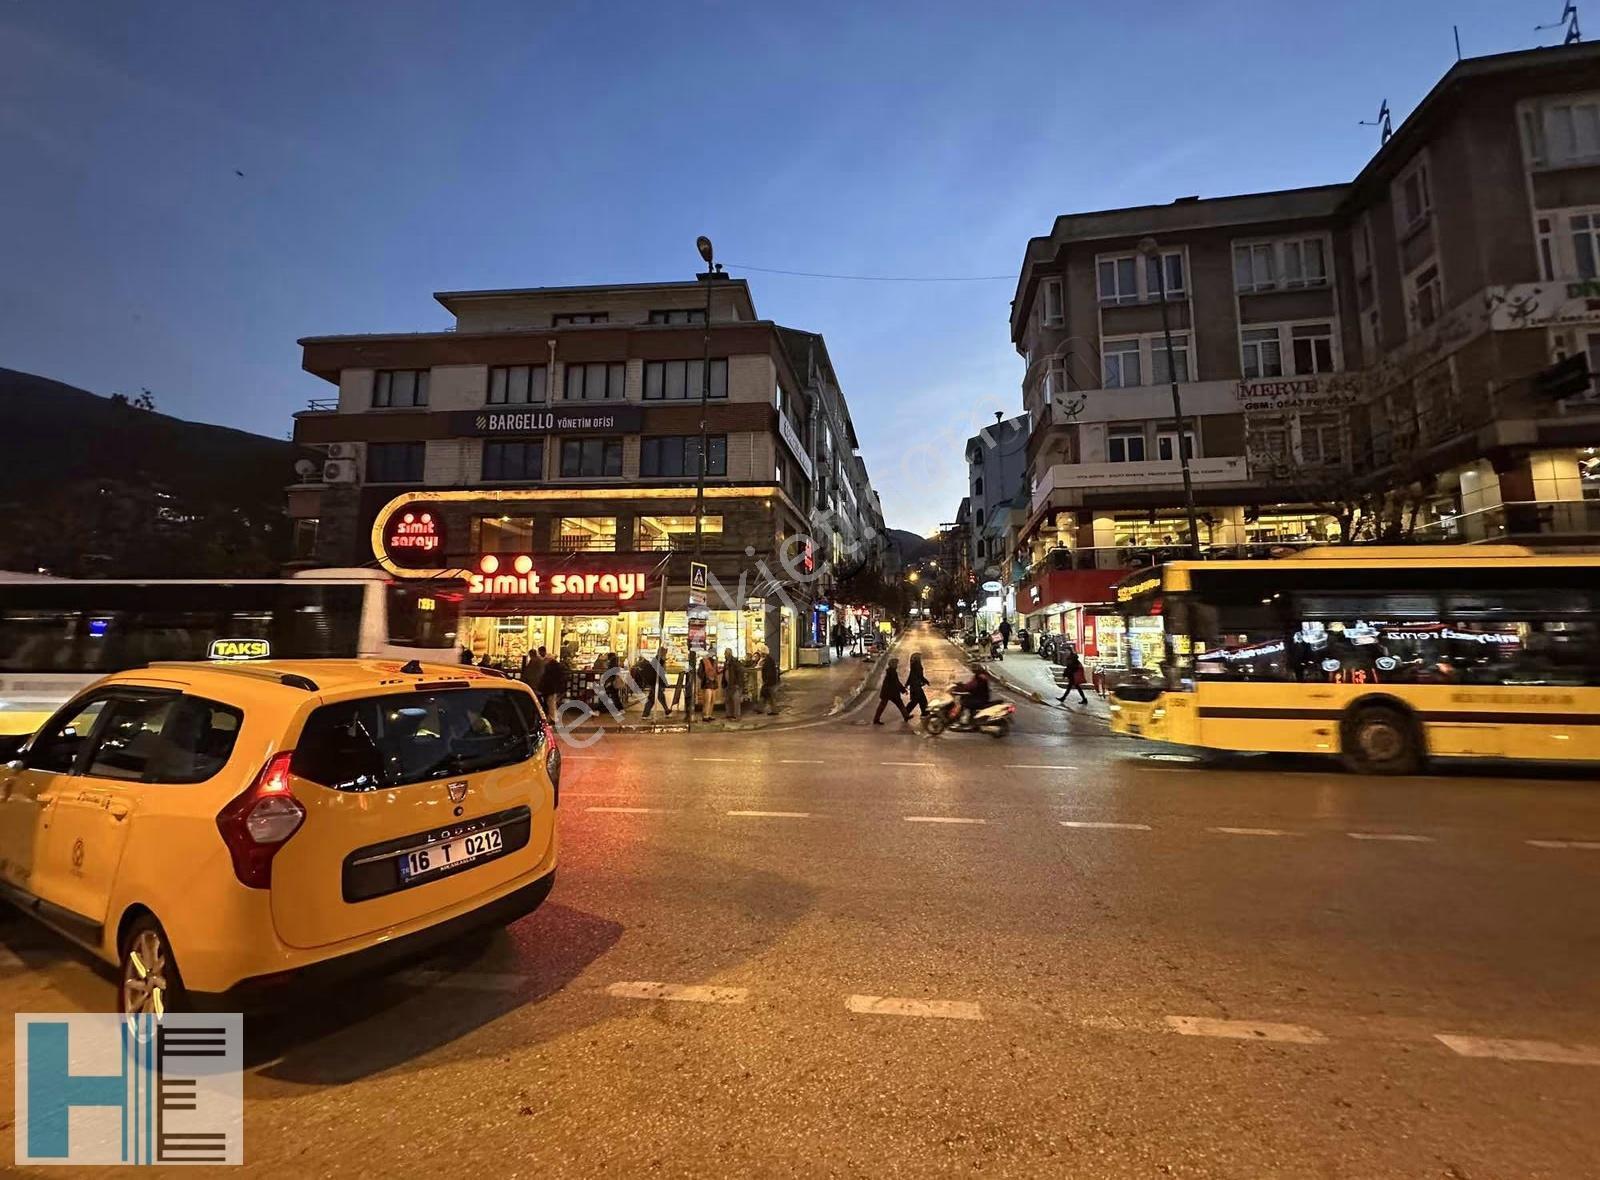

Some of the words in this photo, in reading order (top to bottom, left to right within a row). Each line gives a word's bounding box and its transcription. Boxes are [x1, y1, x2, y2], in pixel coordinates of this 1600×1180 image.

[1239, 380, 1318, 398] MERVE
[488, 413, 554, 430] BARGELLO
[557, 417, 591, 429] YÖNETİM
[397, 513, 435, 534] simit
[469, 555, 540, 594] simit
[551, 573, 646, 600] sarayı
[410, 851, 430, 873] 16
[441, 844, 452, 862] T
[465, 830, 501, 856] 0212
